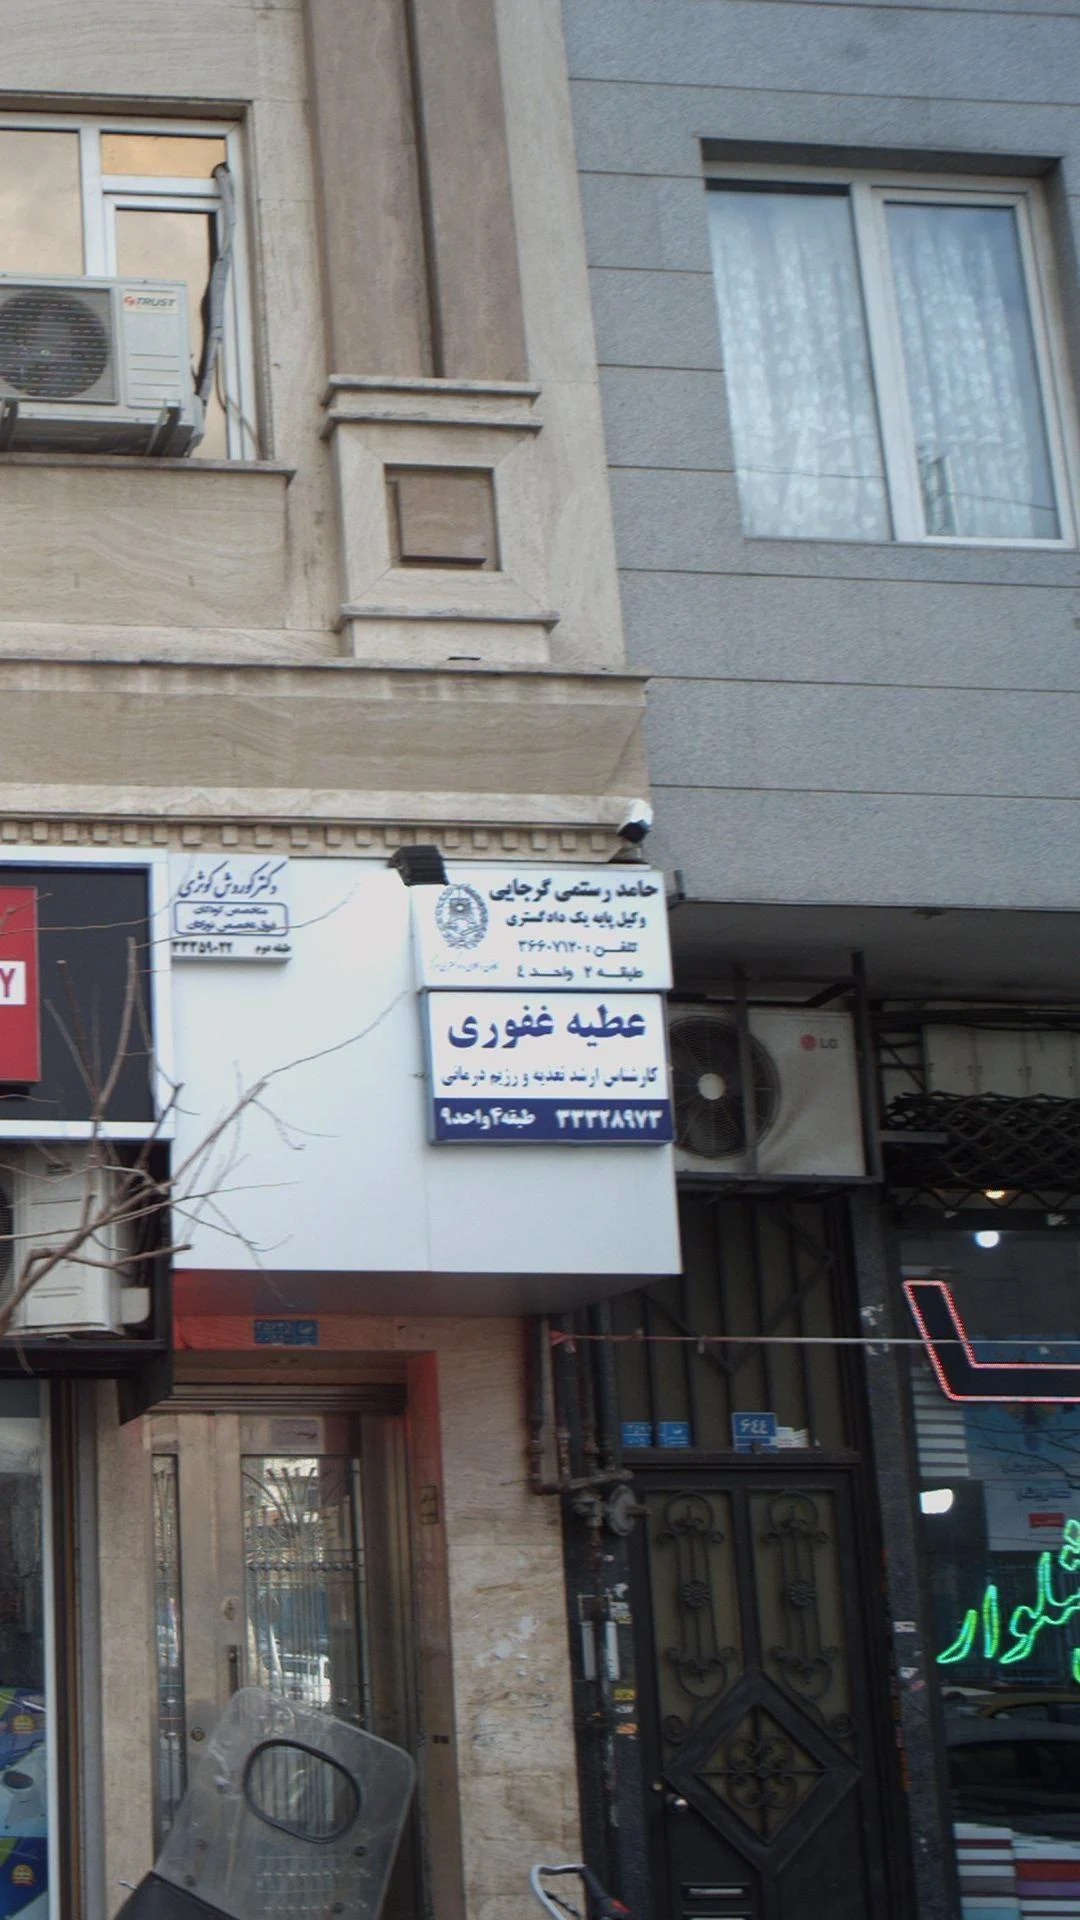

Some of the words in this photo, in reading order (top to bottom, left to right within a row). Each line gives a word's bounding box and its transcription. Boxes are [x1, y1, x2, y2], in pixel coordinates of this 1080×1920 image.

[213, 860, 271, 898] کوروش
[249, 860, 288, 898] دکتر
[615, 879, 658, 898] حامد
[554, 881, 612, 902] رستمی
[505, 910, 566, 927] دادگستری
[569, 911, 588, 928] یک
[592, 911, 613, 929] پایه
[616, 911, 647, 928] وکیل
[597, 966, 644, 982] طبقه
[447, 1004, 555, 1049] غفوری
[566, 1003, 646, 1047] عطیه
[441, 1065, 485, 1087] درمانی
[533, 1066, 565, 1086] تغذیه
[569, 1066, 599, 1088] ارشد
[603, 1066, 658, 1088] کارشناس
